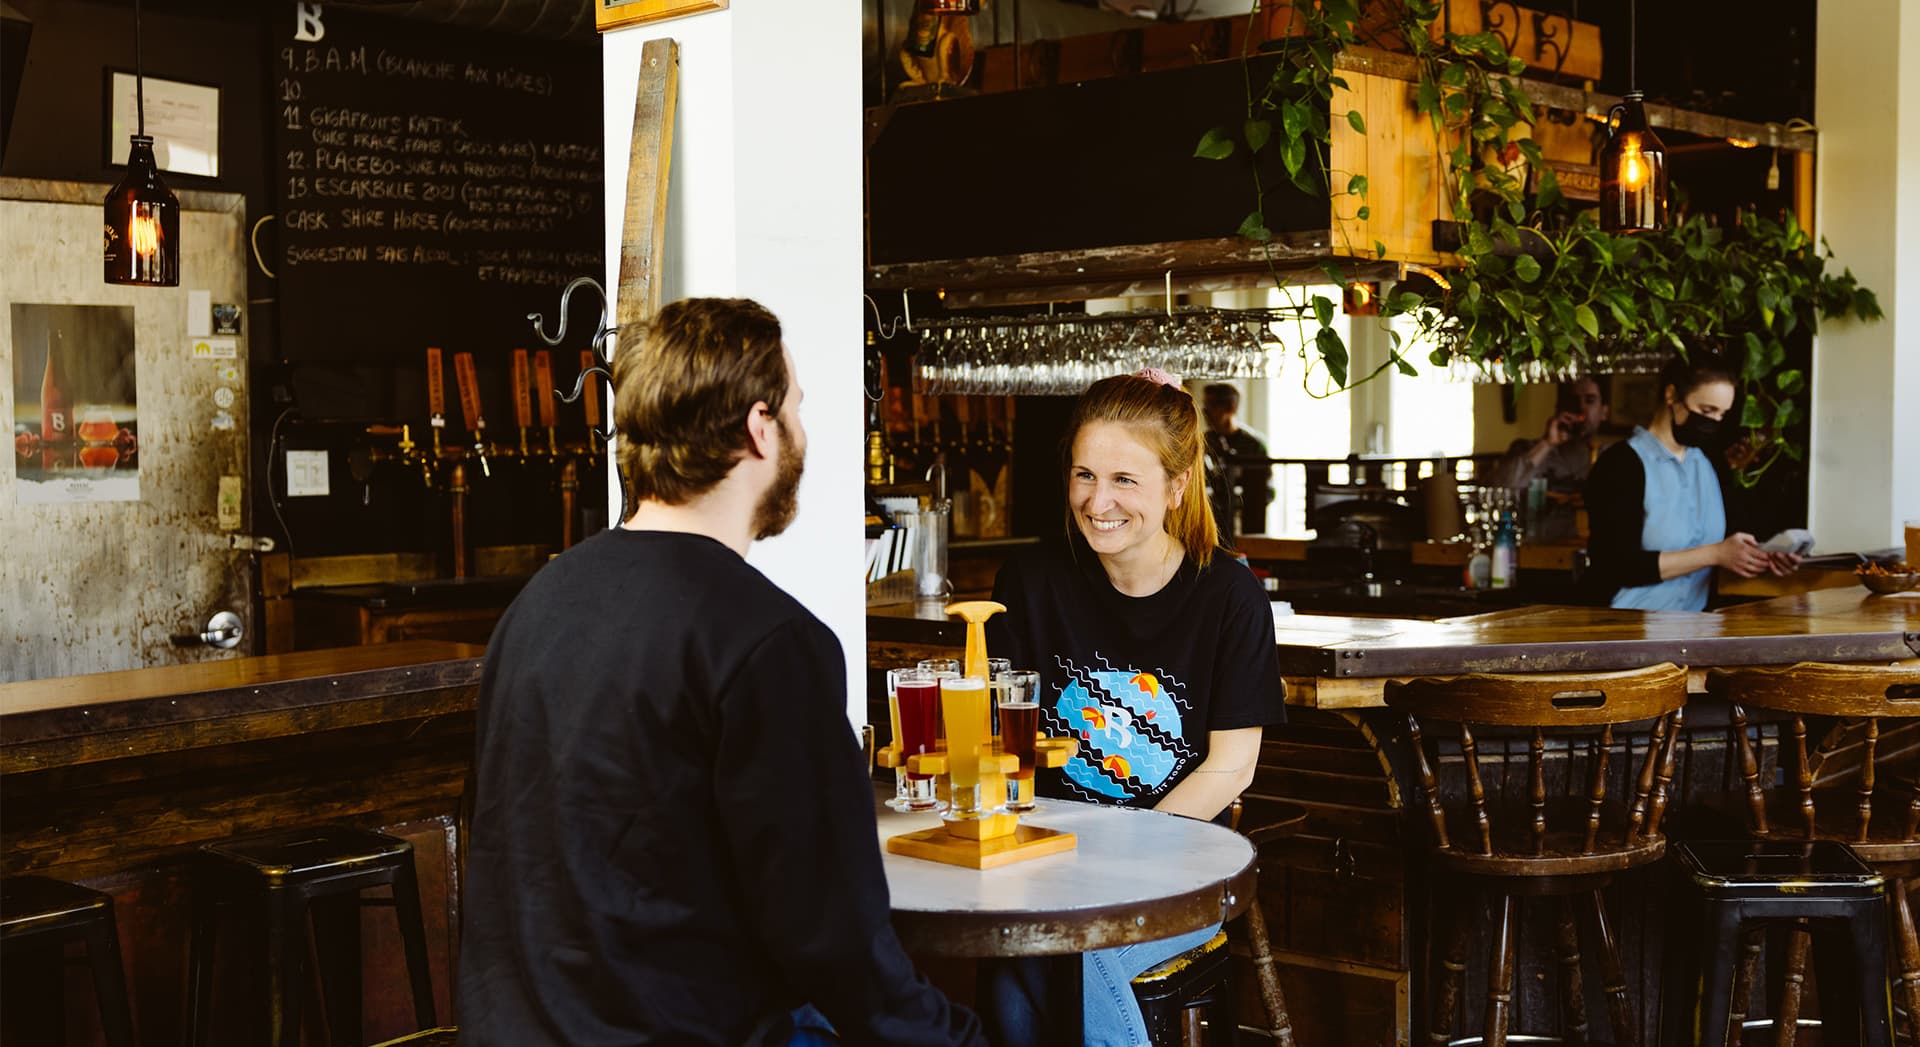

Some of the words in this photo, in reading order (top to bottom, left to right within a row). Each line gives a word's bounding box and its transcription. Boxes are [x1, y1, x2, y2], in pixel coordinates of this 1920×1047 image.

[422, 181, 455, 200] 2021
[393, 208, 439, 231] HORSE
[286, 244, 368, 265] SUGGESTION
[376, 245, 408, 264] SANS
[1100, 703, 1133, 749] B
